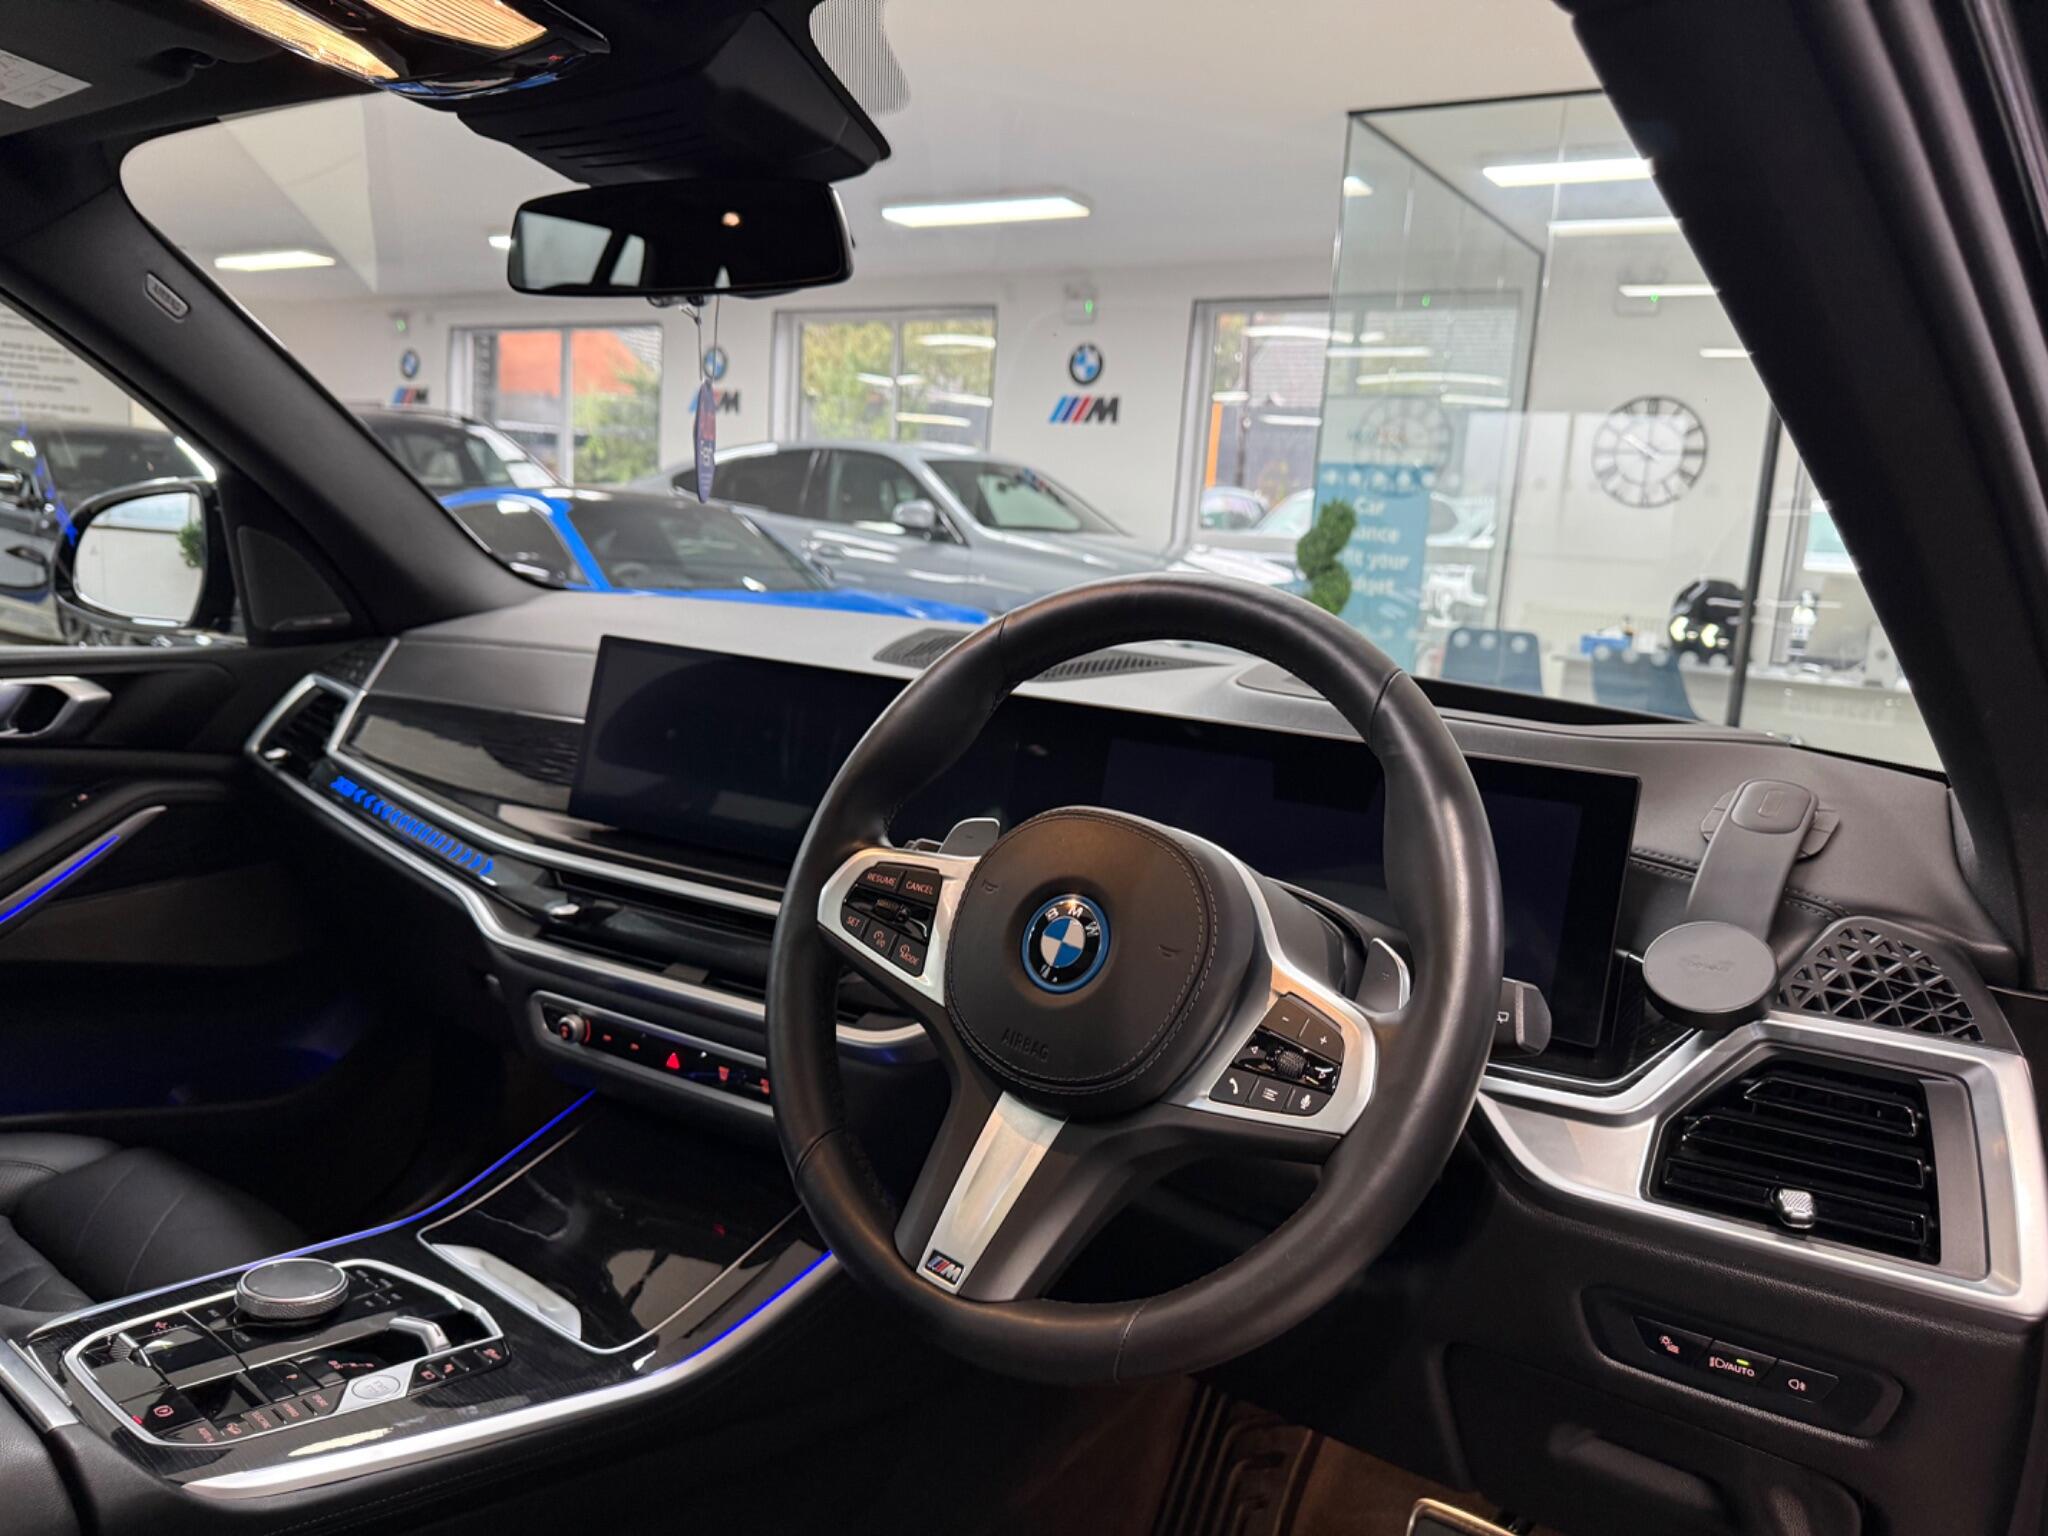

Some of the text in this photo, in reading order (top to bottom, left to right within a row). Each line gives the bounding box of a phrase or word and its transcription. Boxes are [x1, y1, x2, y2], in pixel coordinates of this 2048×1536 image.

[1353, 497, 1386, 516] Car
[1351, 527, 1399, 545] ance
[1368, 552, 1409, 572] your
[867, 872, 896, 886] RESUME
[906, 880, 934, 895] CANCEL
[847, 916, 860, 928] SET
[1045, 905, 1100, 938] BMW
[1001, 1027, 1049, 1062] AIRBAG
